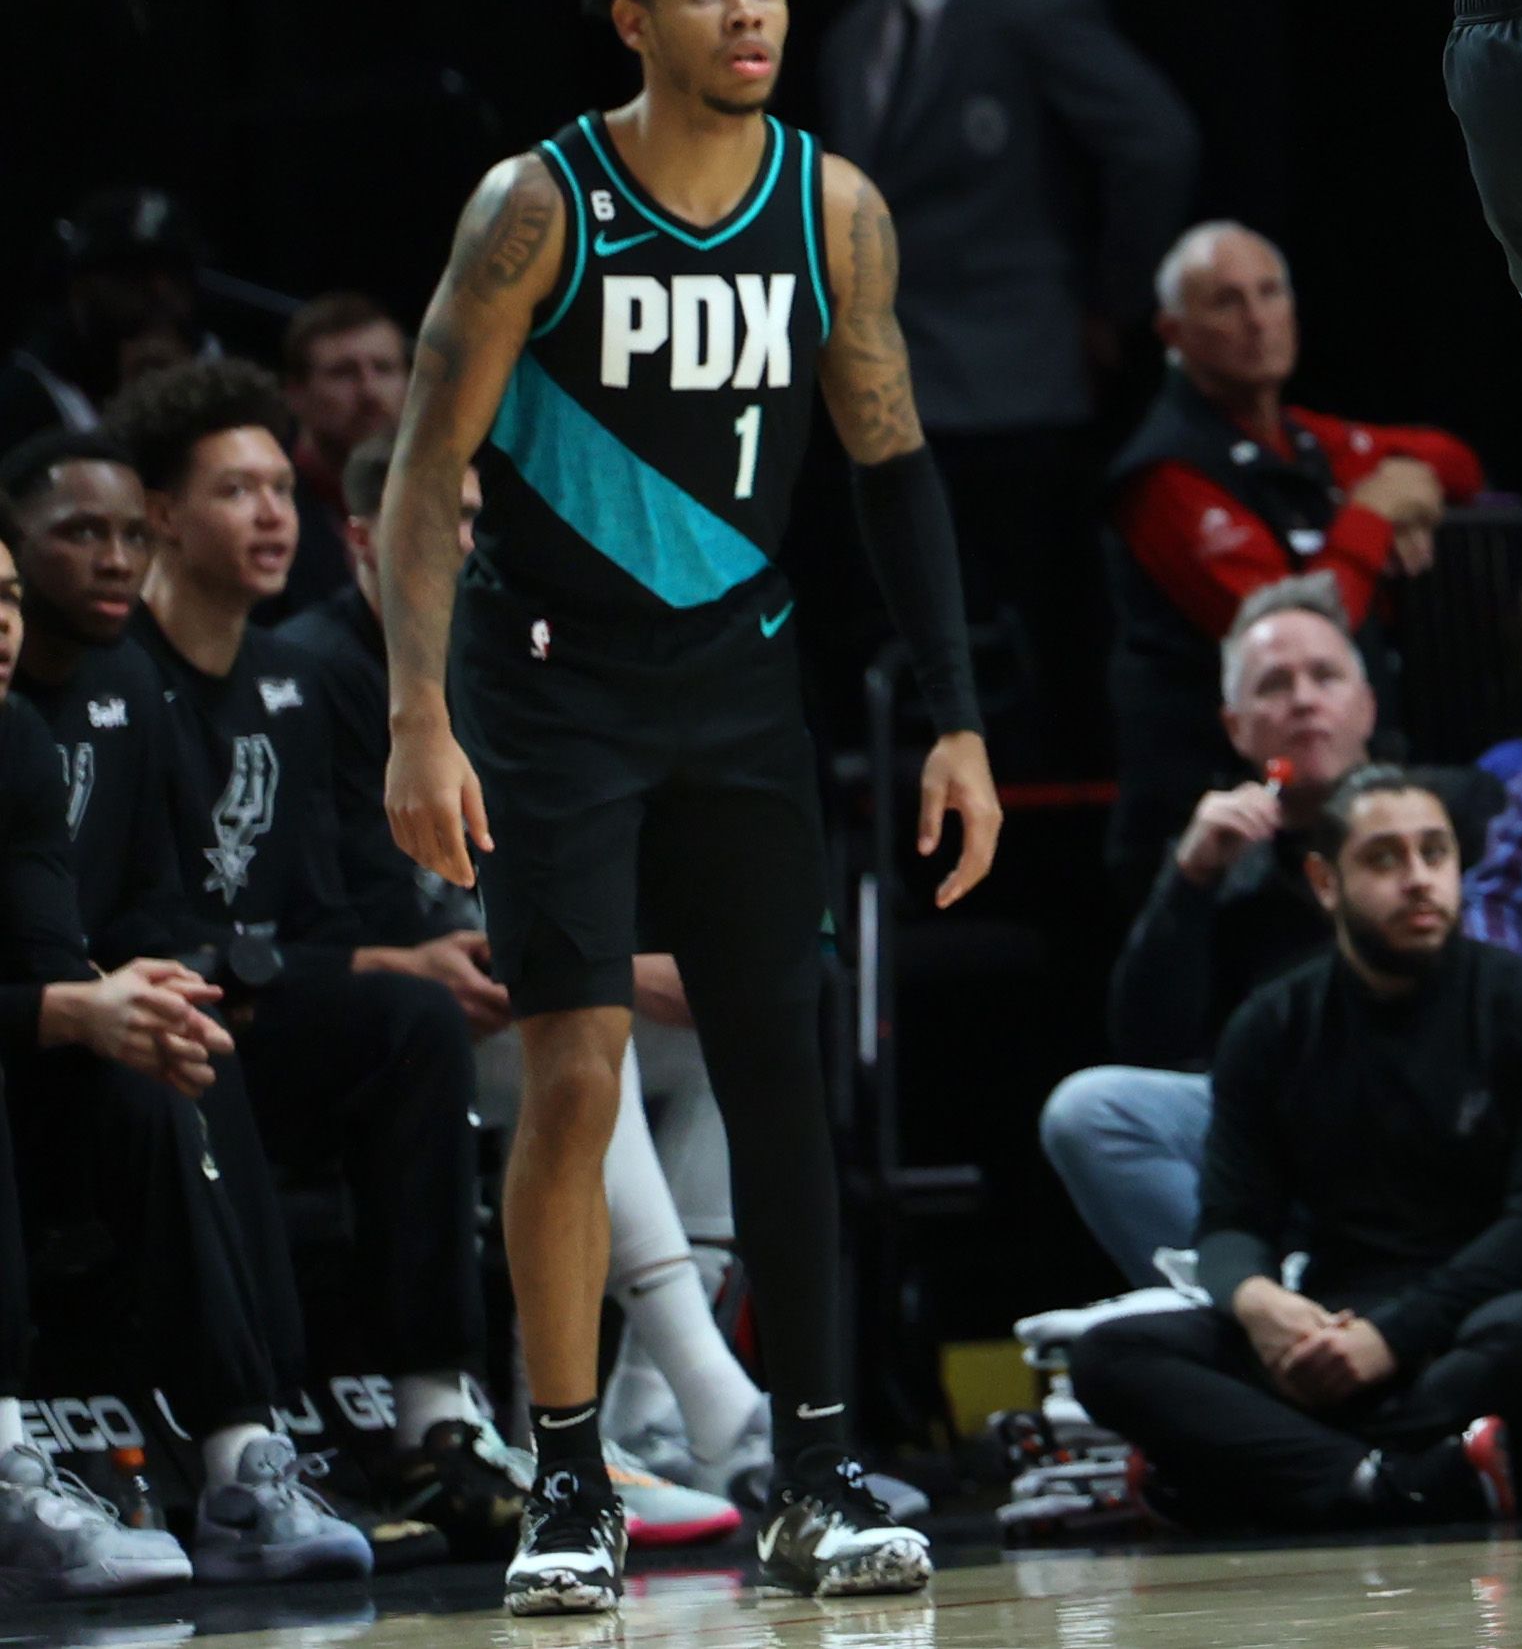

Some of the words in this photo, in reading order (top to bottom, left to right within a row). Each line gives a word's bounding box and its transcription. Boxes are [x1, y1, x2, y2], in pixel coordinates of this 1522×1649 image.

[590, 189, 616, 222] 6
[600, 272, 797, 392] PDX
[734, 404, 765, 500] 1
[21, 1394, 146, 1453] EICO
